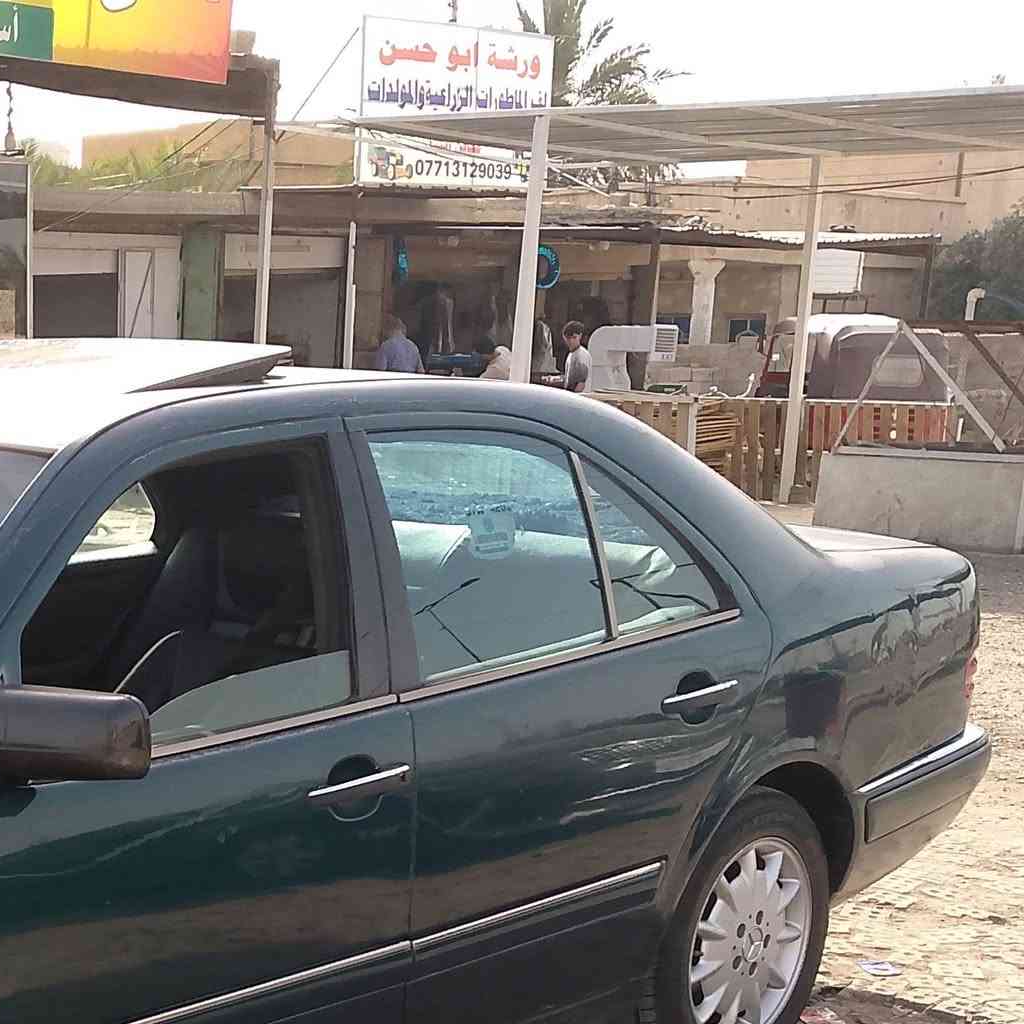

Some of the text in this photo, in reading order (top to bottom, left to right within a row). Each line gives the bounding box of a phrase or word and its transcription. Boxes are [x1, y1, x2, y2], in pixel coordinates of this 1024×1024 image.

[378, 40, 542, 80] ورشة ابو حسن
[415, 159, 512, 180] 07713129039
